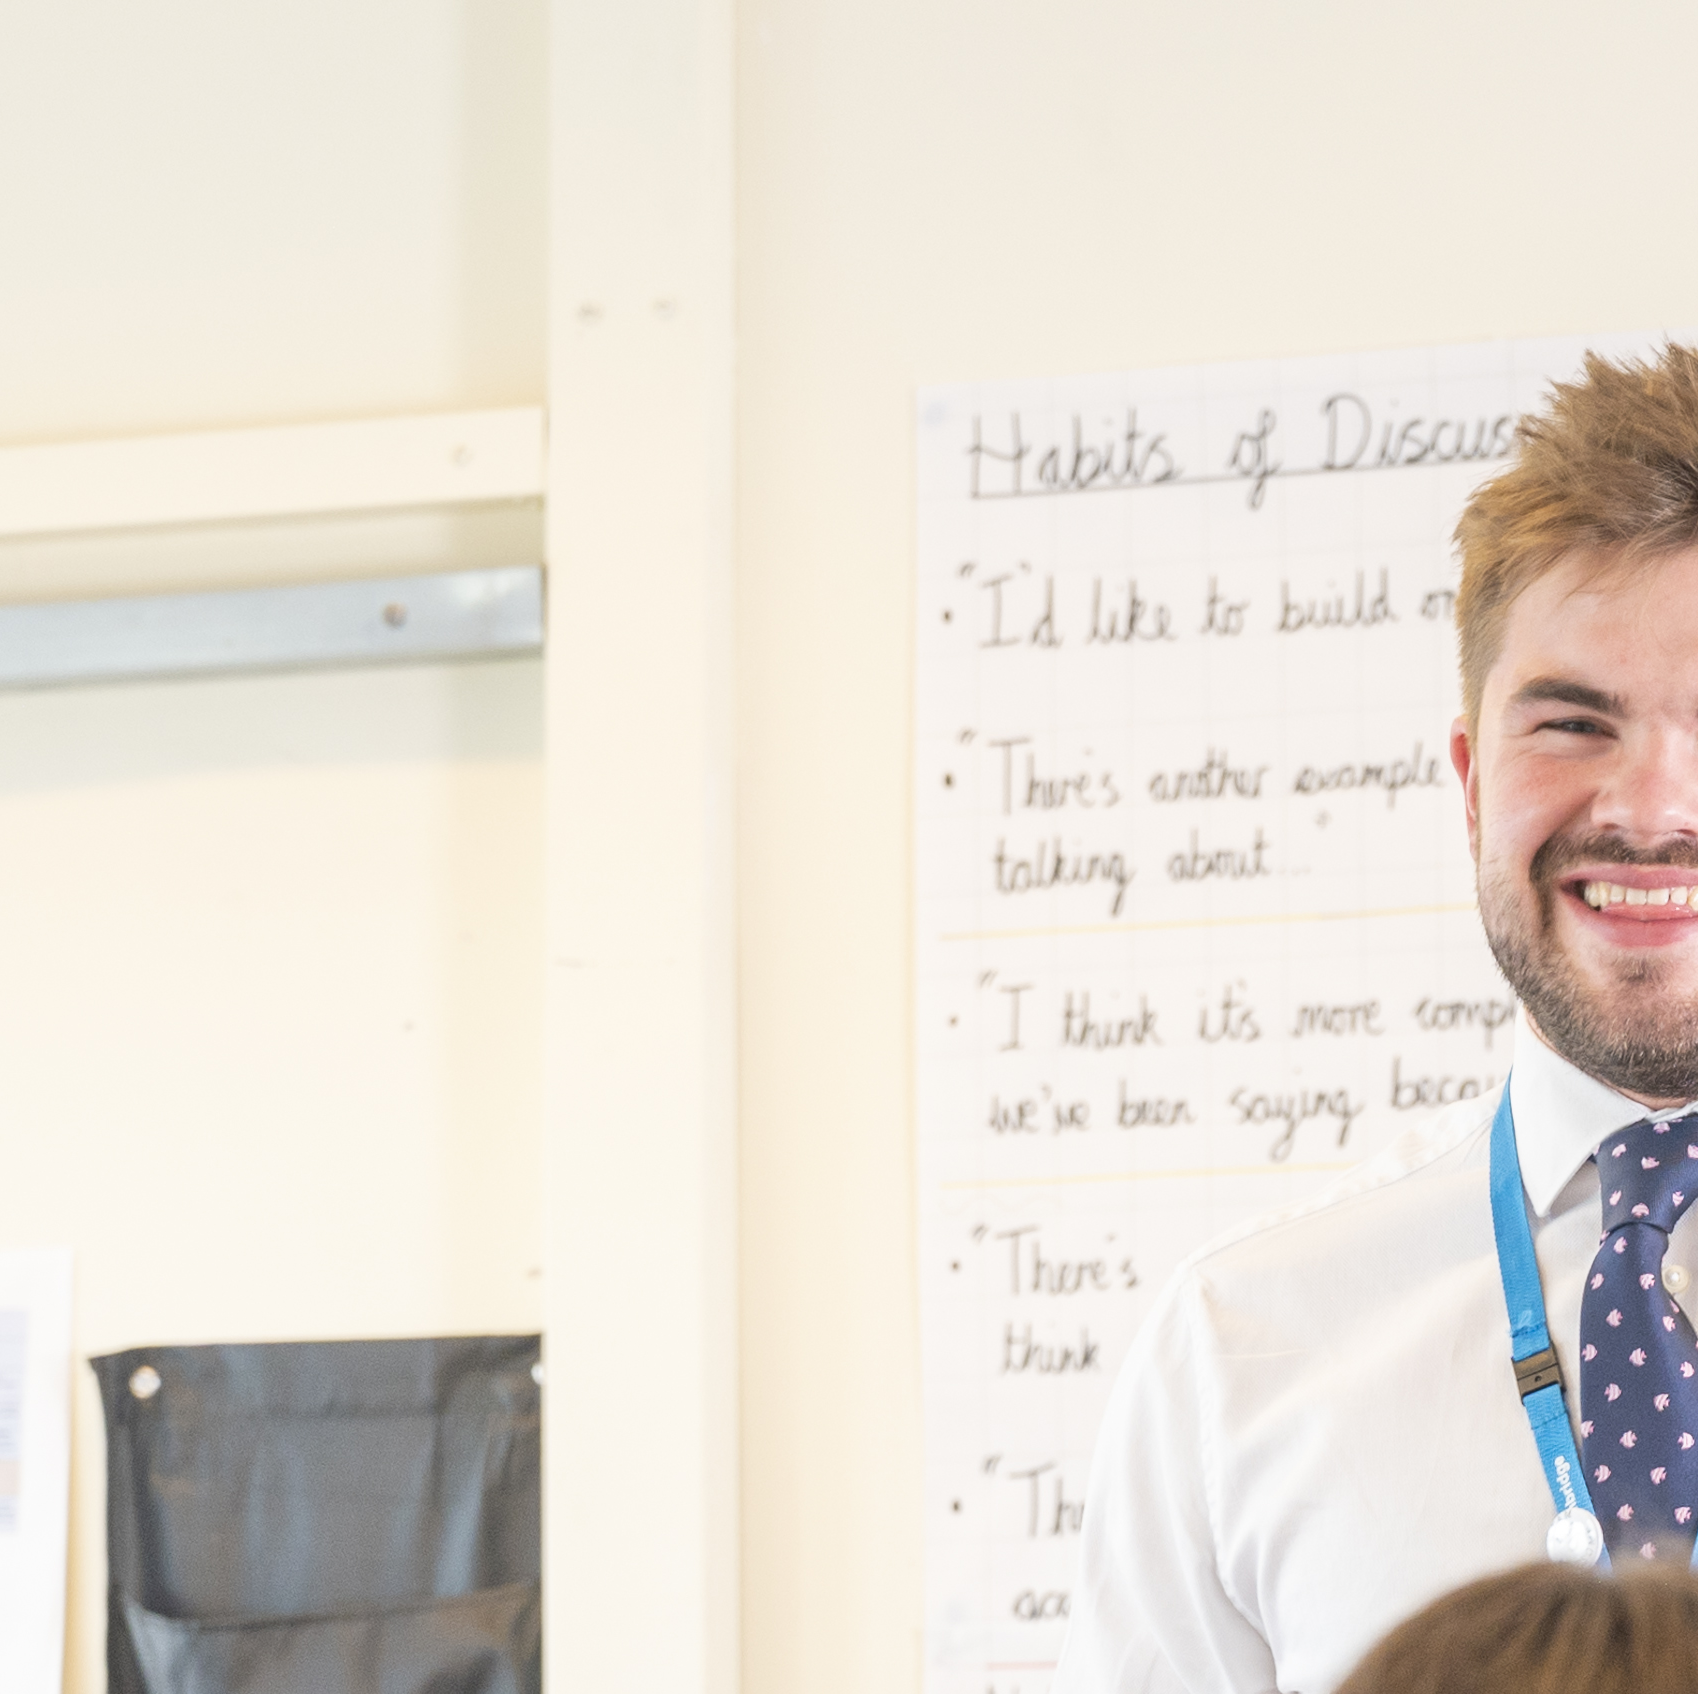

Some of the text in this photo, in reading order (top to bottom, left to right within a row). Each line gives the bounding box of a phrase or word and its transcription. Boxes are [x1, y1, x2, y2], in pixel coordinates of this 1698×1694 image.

[965, 393, 1515, 510] Habits of Discus
[1086, 576, 1178, 646] like
[1199, 573, 1252, 636] to
[1274, 564, 1400, 634] build
[1148, 744, 1273, 803] another
[1292, 738, 1446, 811] example
[992, 834, 1138, 919] talking
[1062, 989, 1163, 1052] think
[1198, 978, 1262, 1044] it's
[1291, 997, 1387, 1038] more
[989, 1083, 1090, 1135] we've
[1117, 1079, 1196, 1131] been
[1230, 1075, 1367, 1164] saying
[1001, 1320, 1101, 1375] think
